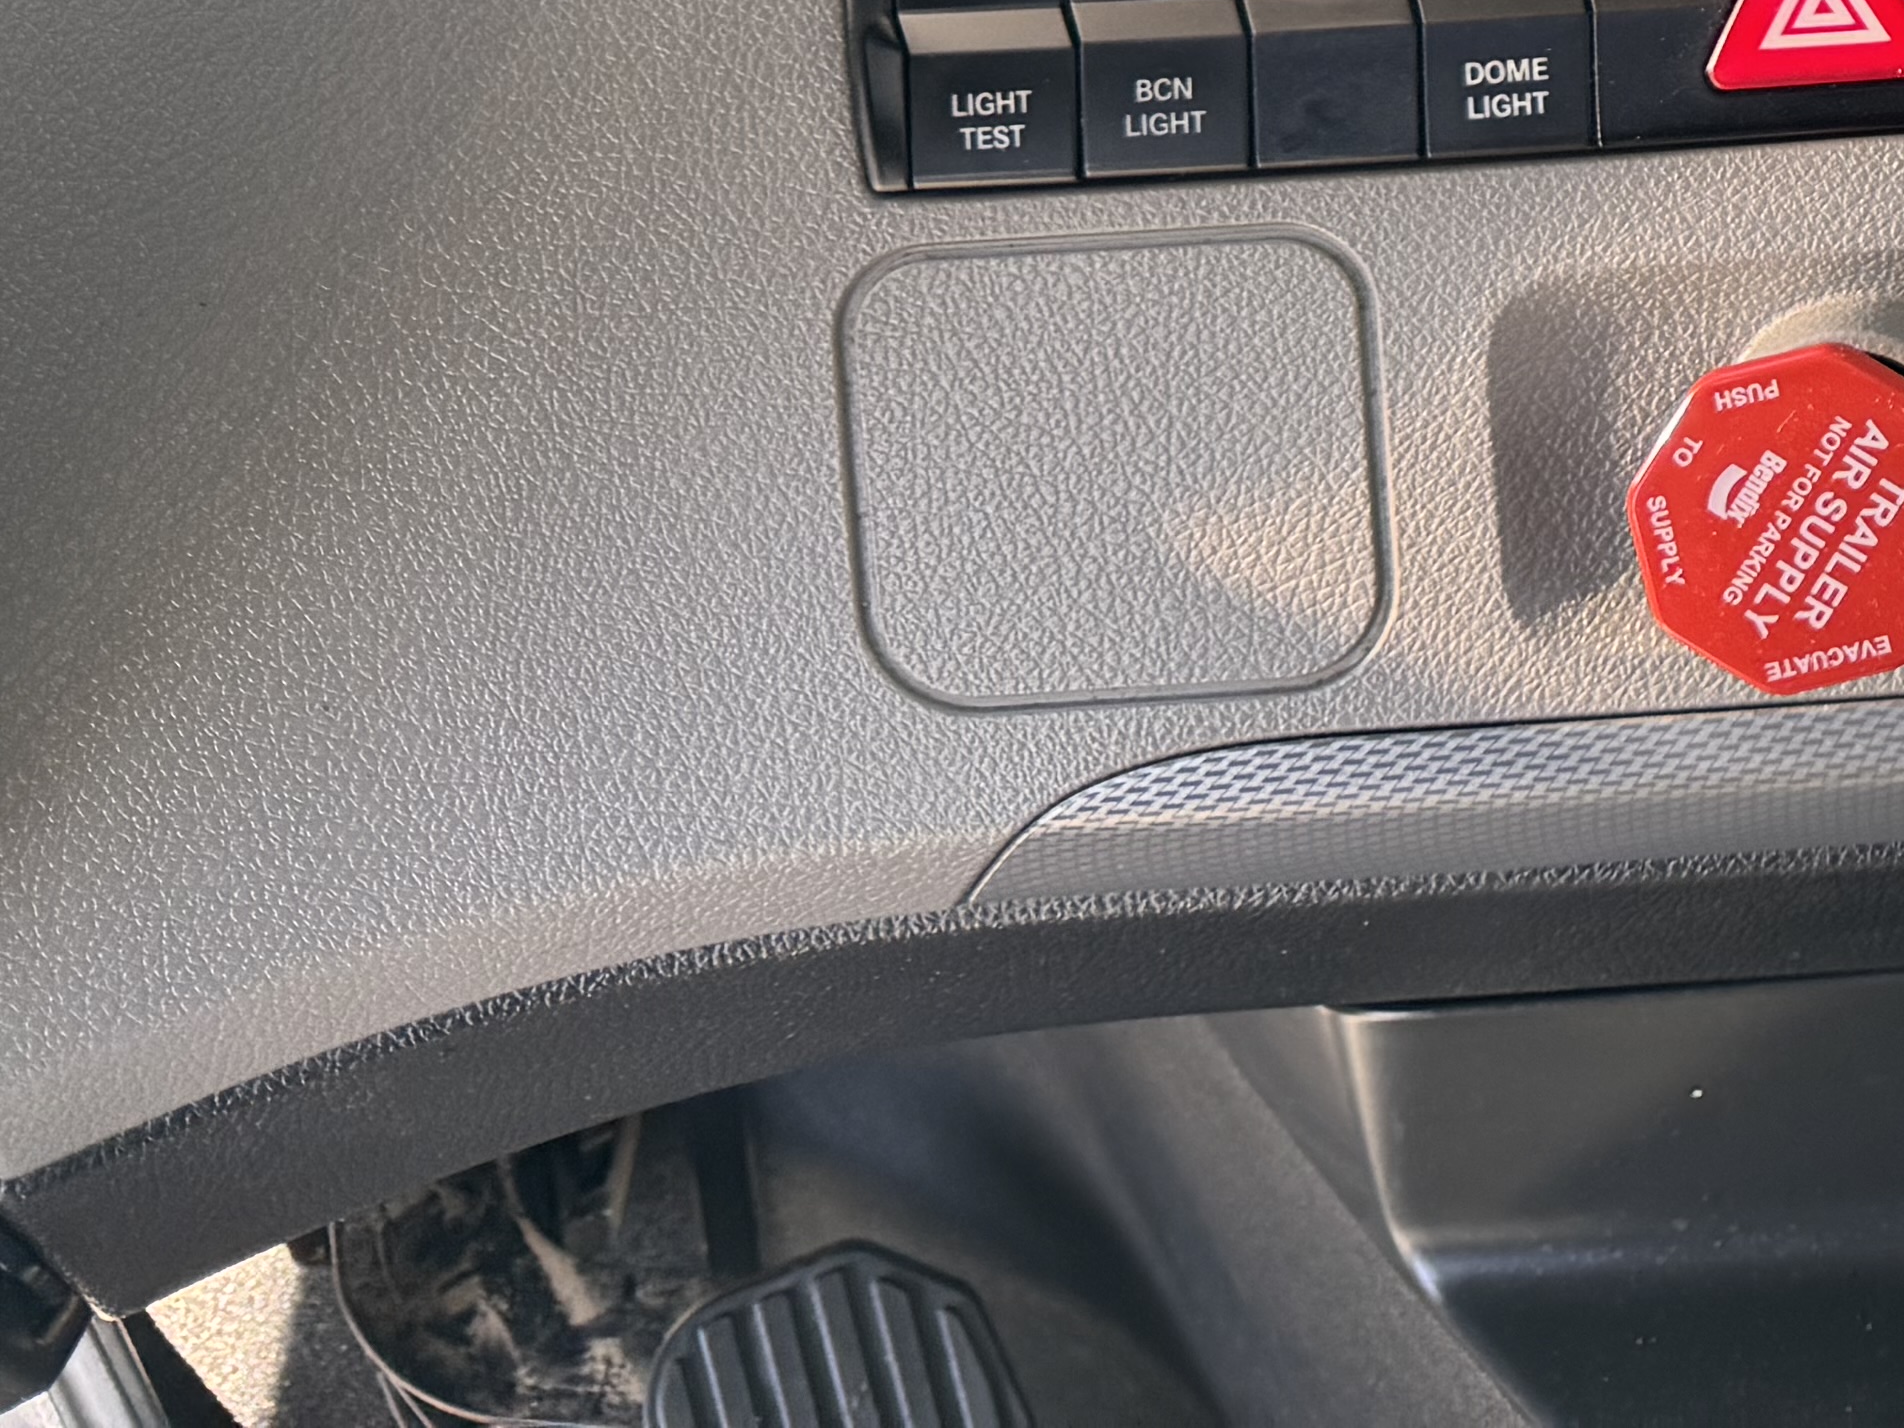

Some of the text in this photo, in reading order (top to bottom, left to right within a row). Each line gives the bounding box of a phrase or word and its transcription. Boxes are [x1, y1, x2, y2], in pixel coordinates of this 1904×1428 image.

[1464, 56, 1549, 87] DOME
[951, 89, 1032, 118] LIGHT
[1134, 76, 1194, 104] BCN
[1466, 90, 1549, 120] LIGHT
[959, 123, 1026, 151] TEST
[1124, 109, 1207, 138] LIGHT
[1646, 379, 1780, 586] PUSH TO SUPPLY
[1726, 449, 1788, 529] Bendix
[1722, 415, 1853, 606] NOT FOR PARKING
[1744, 418, 1890, 640] AIR SUPPLY
[1764, 635, 1892, 683] EVACUATE
